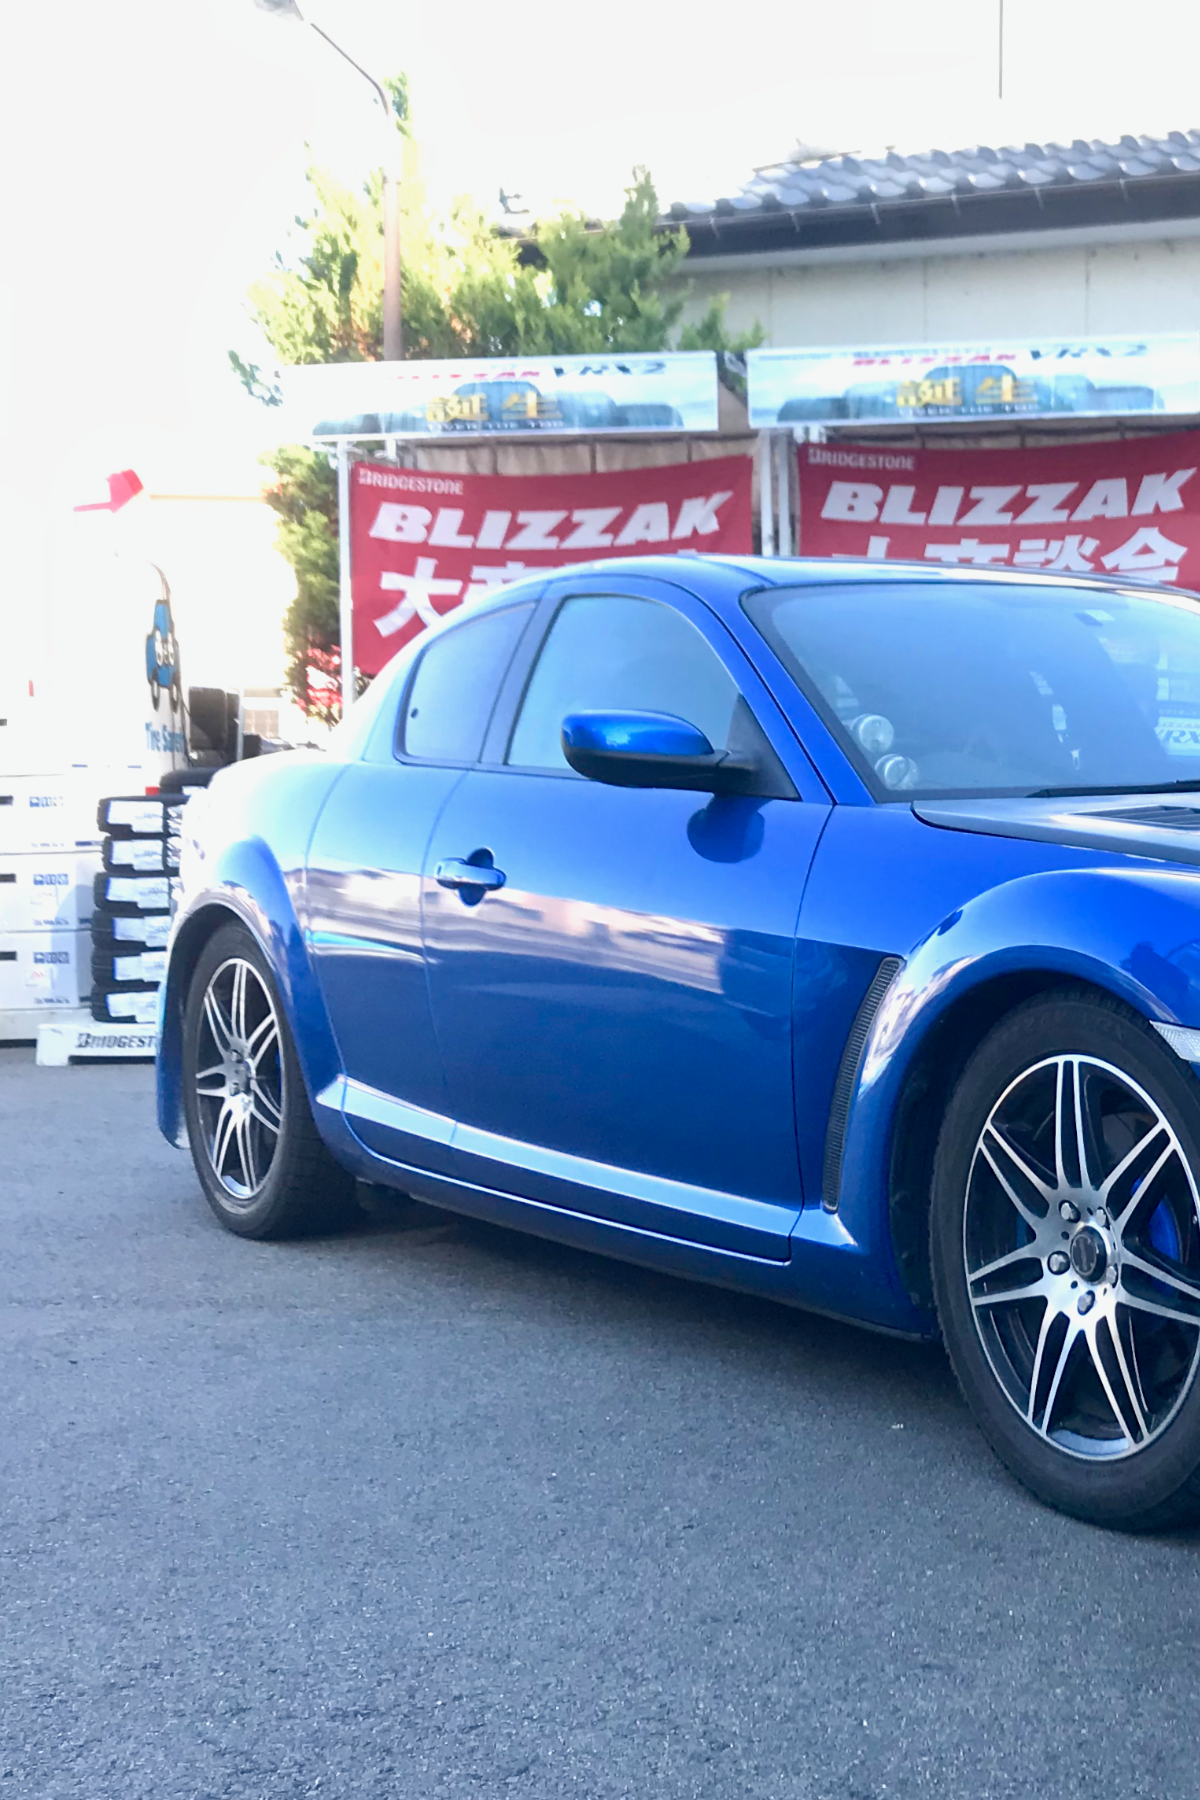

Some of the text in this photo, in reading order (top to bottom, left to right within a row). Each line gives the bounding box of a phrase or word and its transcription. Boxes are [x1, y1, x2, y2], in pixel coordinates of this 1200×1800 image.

[808, 447, 915, 471] BRIDGESTONE
[358, 468, 463, 495] BRIDGESTONE
[821, 467, 1197, 526] BLIZZAK
[369, 490, 734, 550] BLIZZAK
[76, 1032, 157, 1049] BRIDGEST
